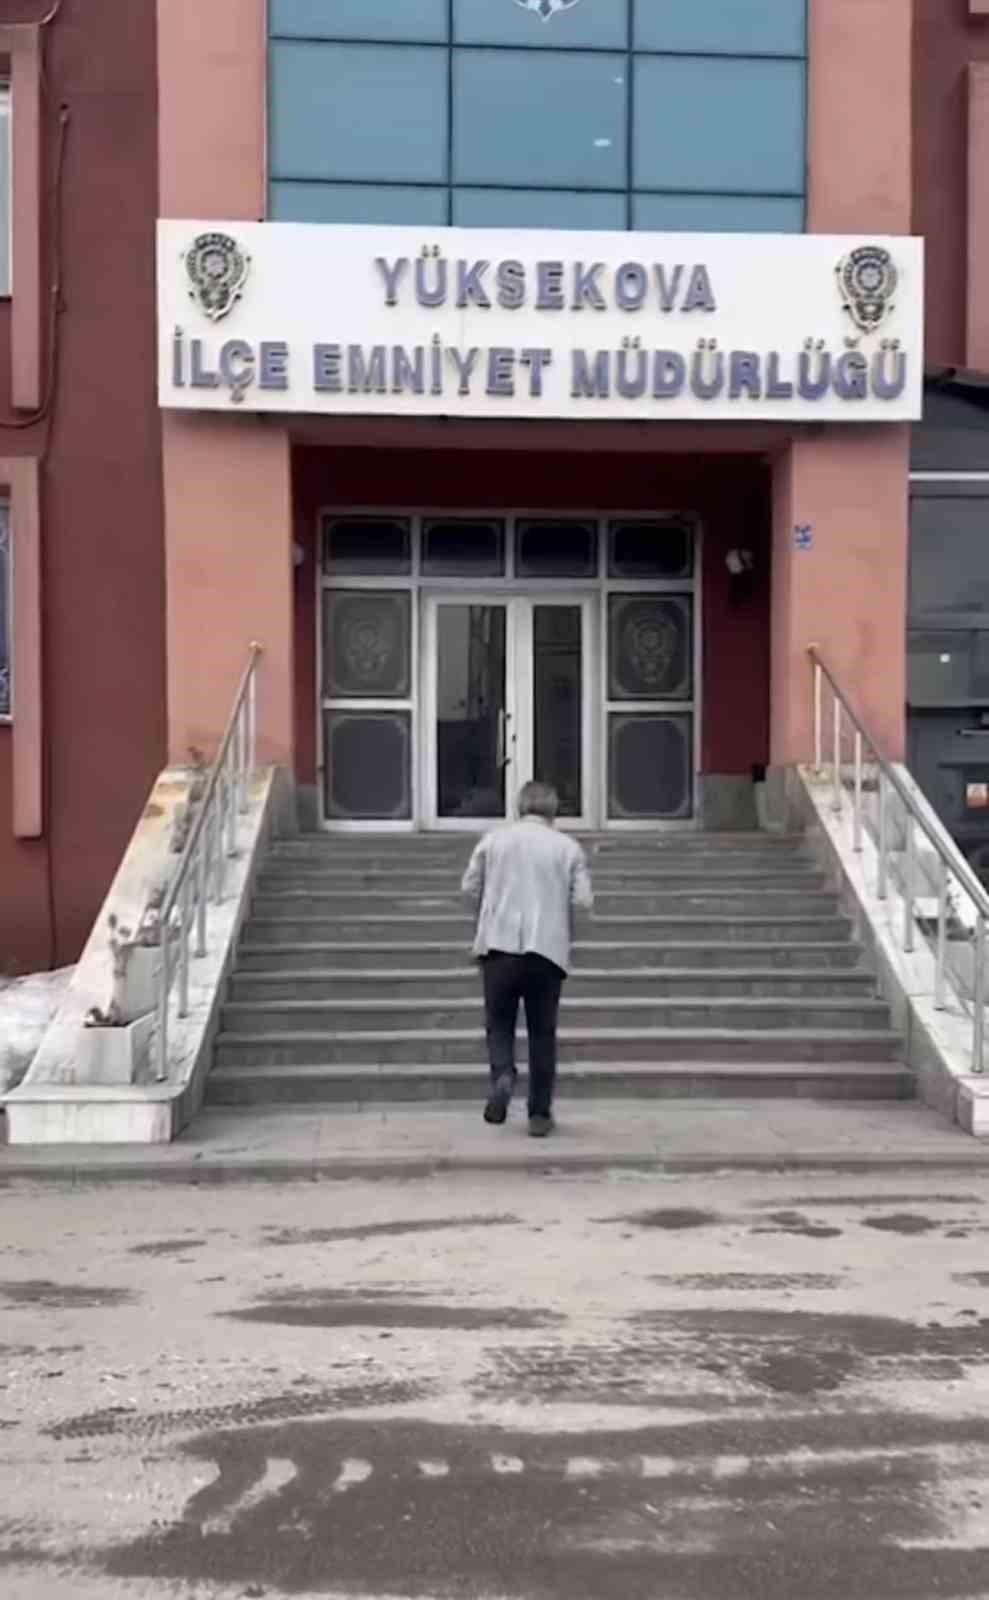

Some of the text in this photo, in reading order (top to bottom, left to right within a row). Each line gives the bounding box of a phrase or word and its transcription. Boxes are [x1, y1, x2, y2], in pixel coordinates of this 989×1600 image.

[375, 245, 716, 312] YÜKSEKOVA
[172, 325, 906, 403] İLÇE EMNİYET MÜDÜRLÜĞÜ
